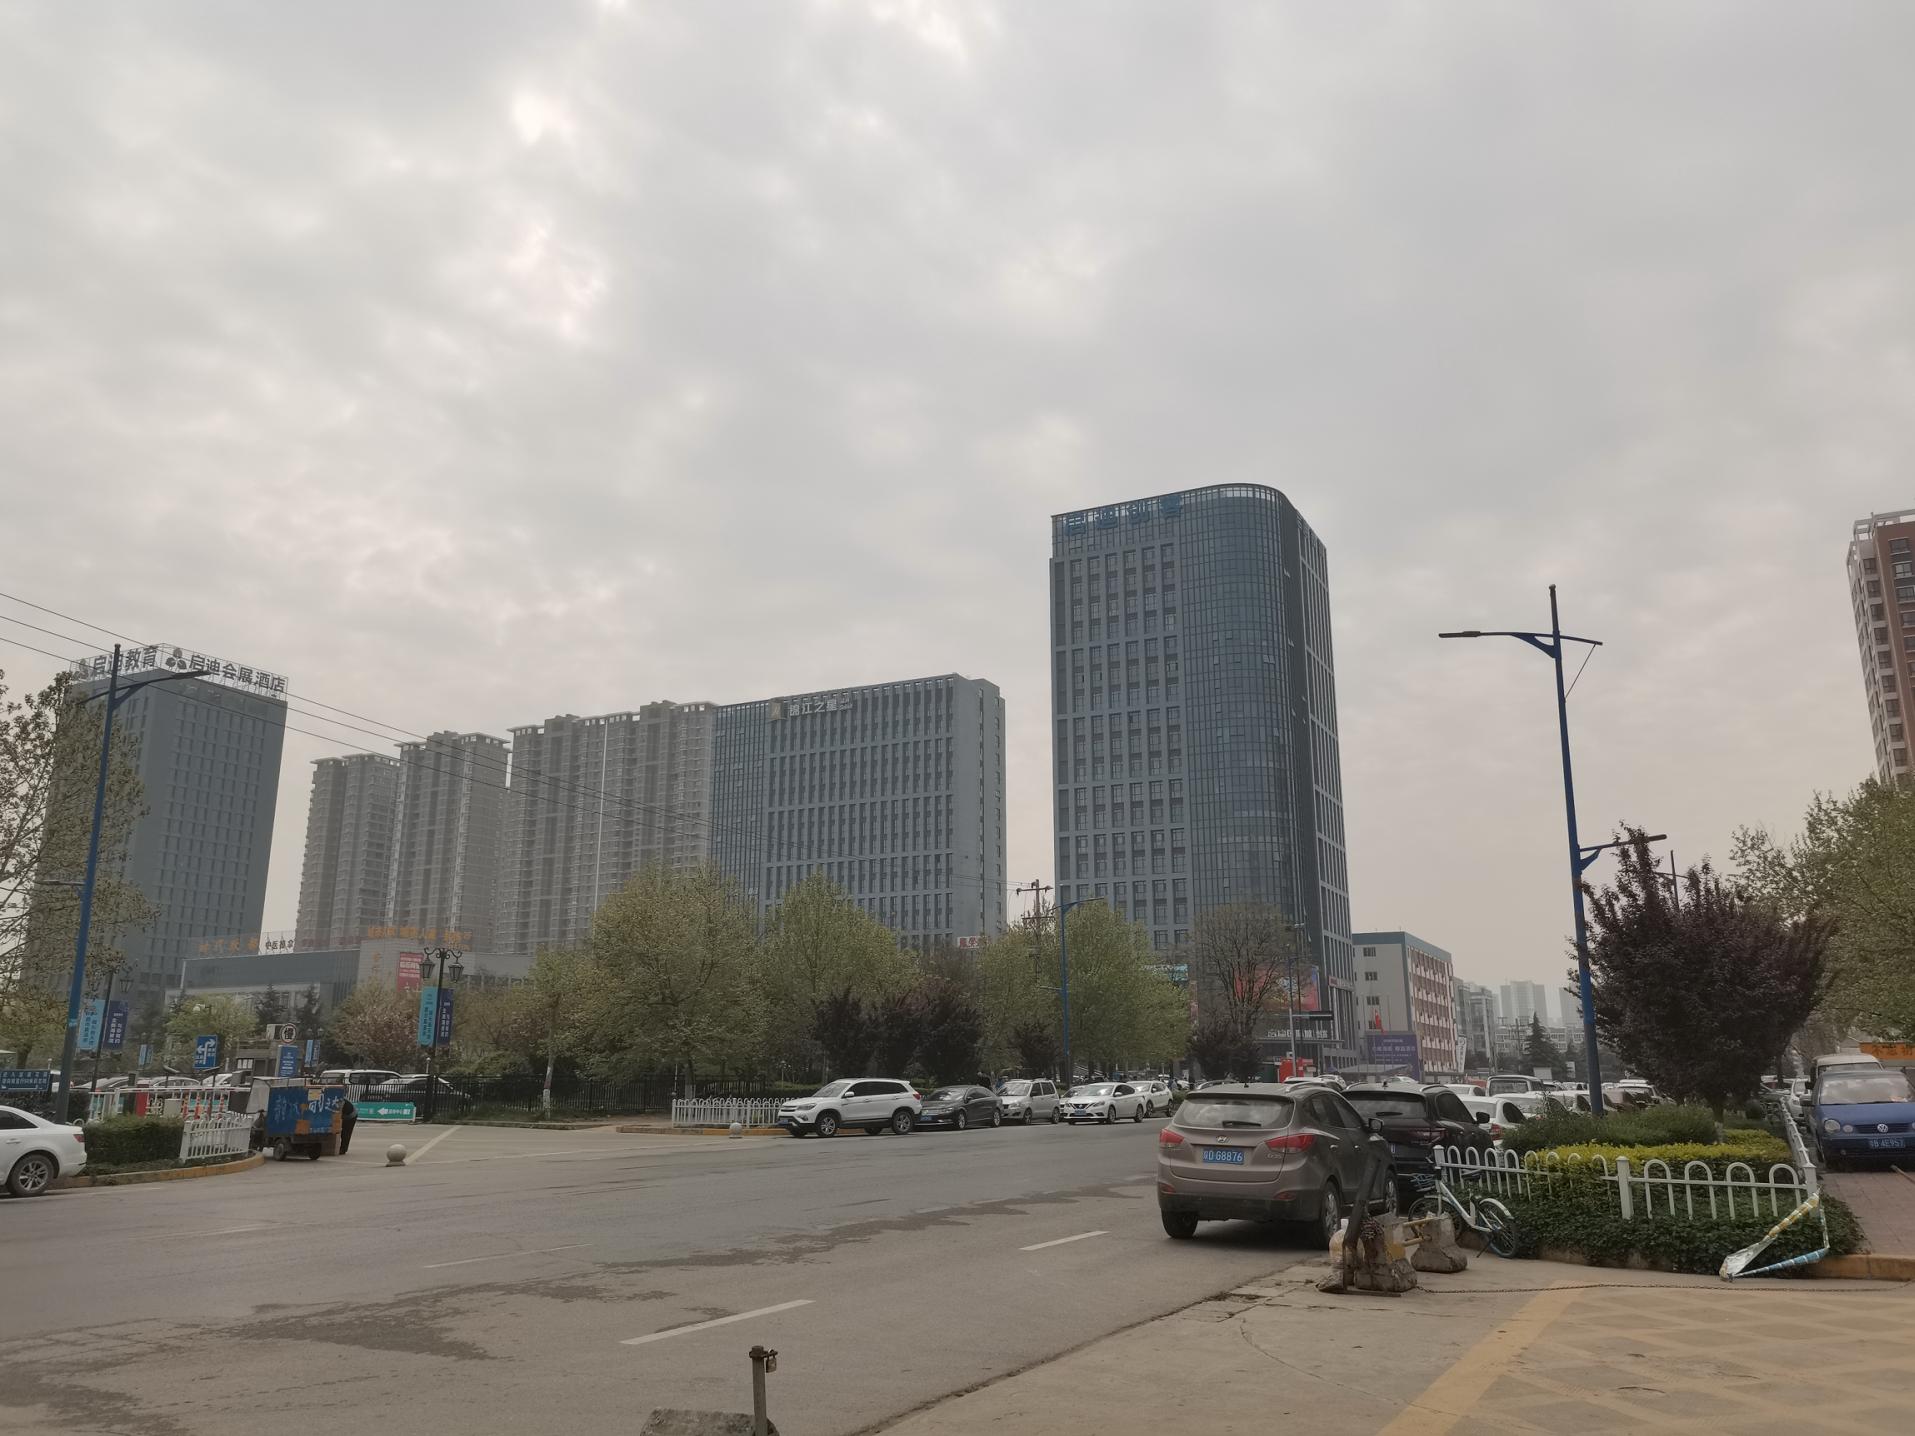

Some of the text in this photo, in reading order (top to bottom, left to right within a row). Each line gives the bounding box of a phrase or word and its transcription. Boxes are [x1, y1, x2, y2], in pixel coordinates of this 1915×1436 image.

[189, 655, 285, 692] 启迪会展酒店
